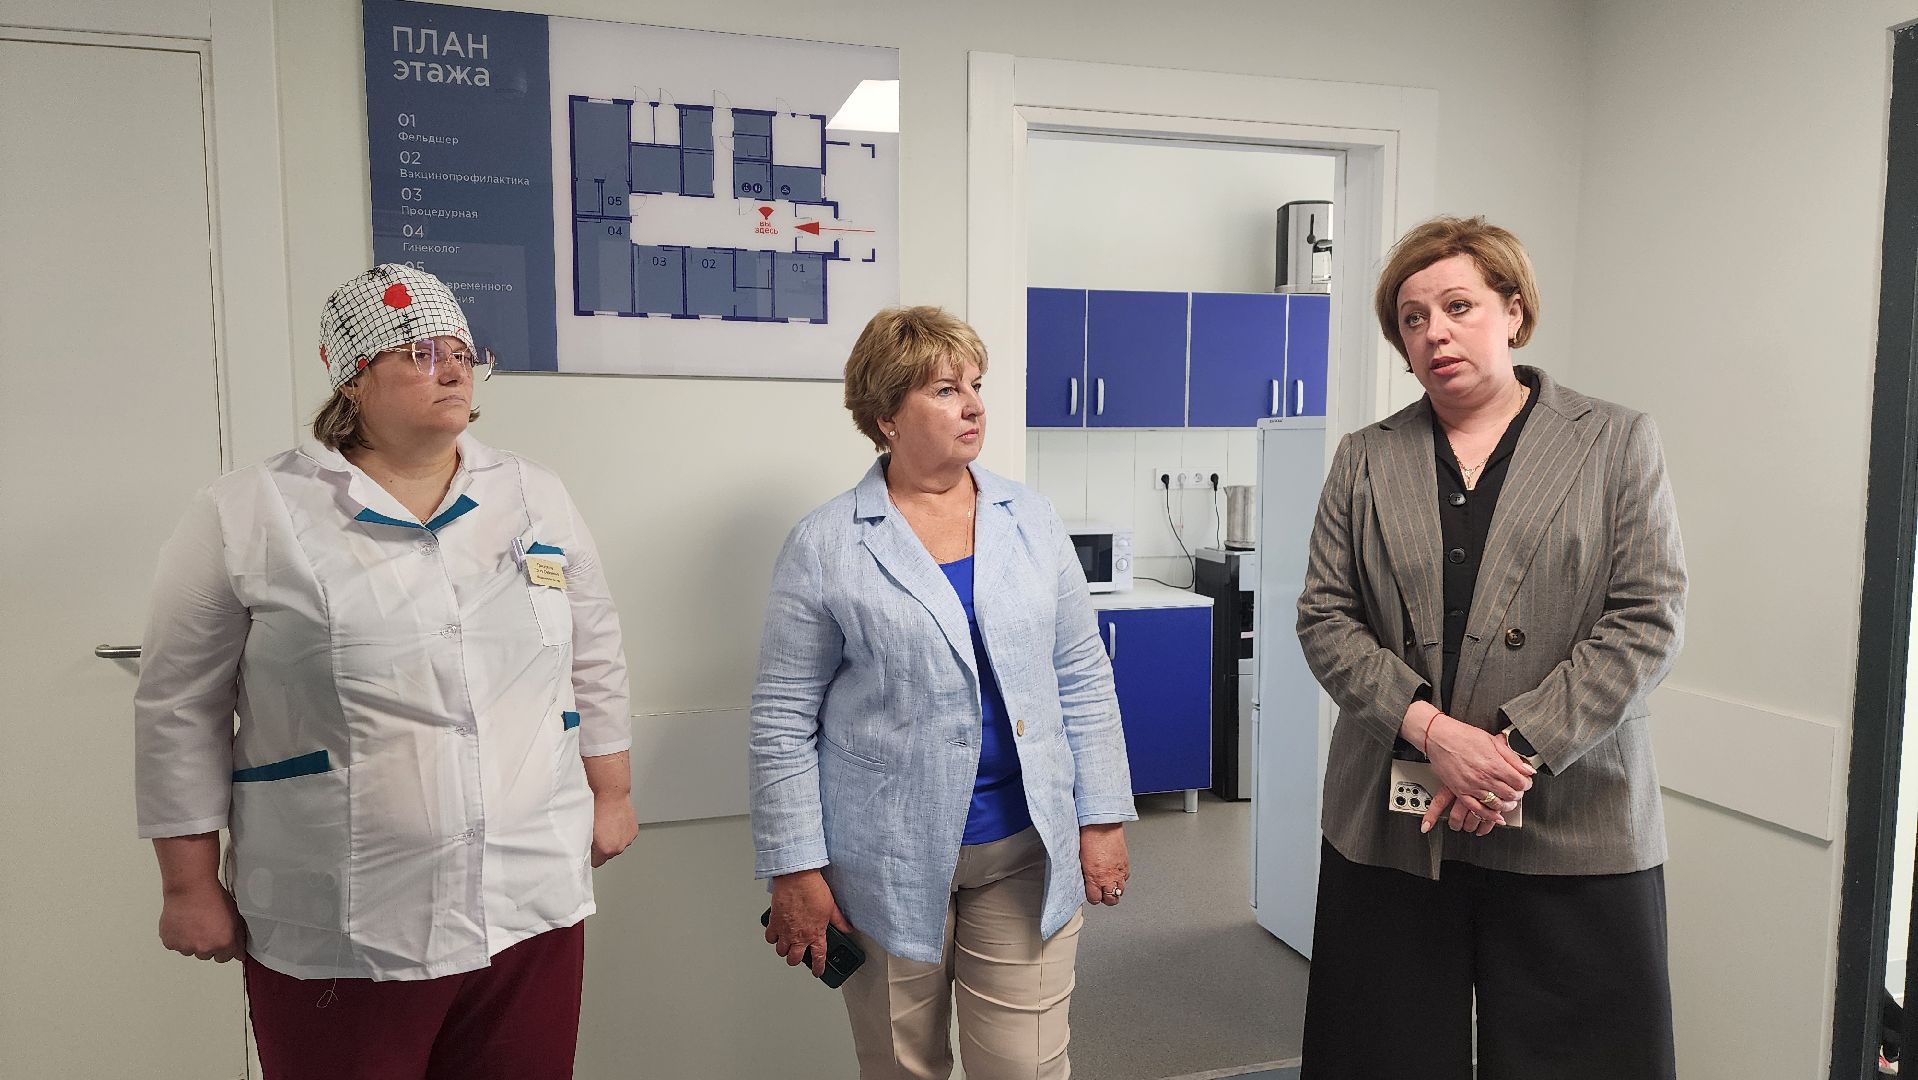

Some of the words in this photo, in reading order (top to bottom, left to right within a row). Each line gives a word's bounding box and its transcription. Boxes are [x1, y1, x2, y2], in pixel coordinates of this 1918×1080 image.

[392, 26, 489, 60] ПЛАН
[393, 59, 490, 87] этажа
[398, 113, 416, 127] 01
[398, 131, 459, 146] Фельдшер
[399, 151, 421, 165] 02
[400, 169, 530, 186] Вакцинопрофилактика
[401, 187, 422, 201] 03
[607, 195, 622, 206] 05
[401, 205, 478, 219] Процедурная
[402, 224, 424, 238] 04
[607, 226, 623, 236] 04
[403, 243, 460, 254] Гинеколог
[652, 257, 667, 267] 03
[701, 259, 716, 269] 02
[791, 263, 805, 273] 01
